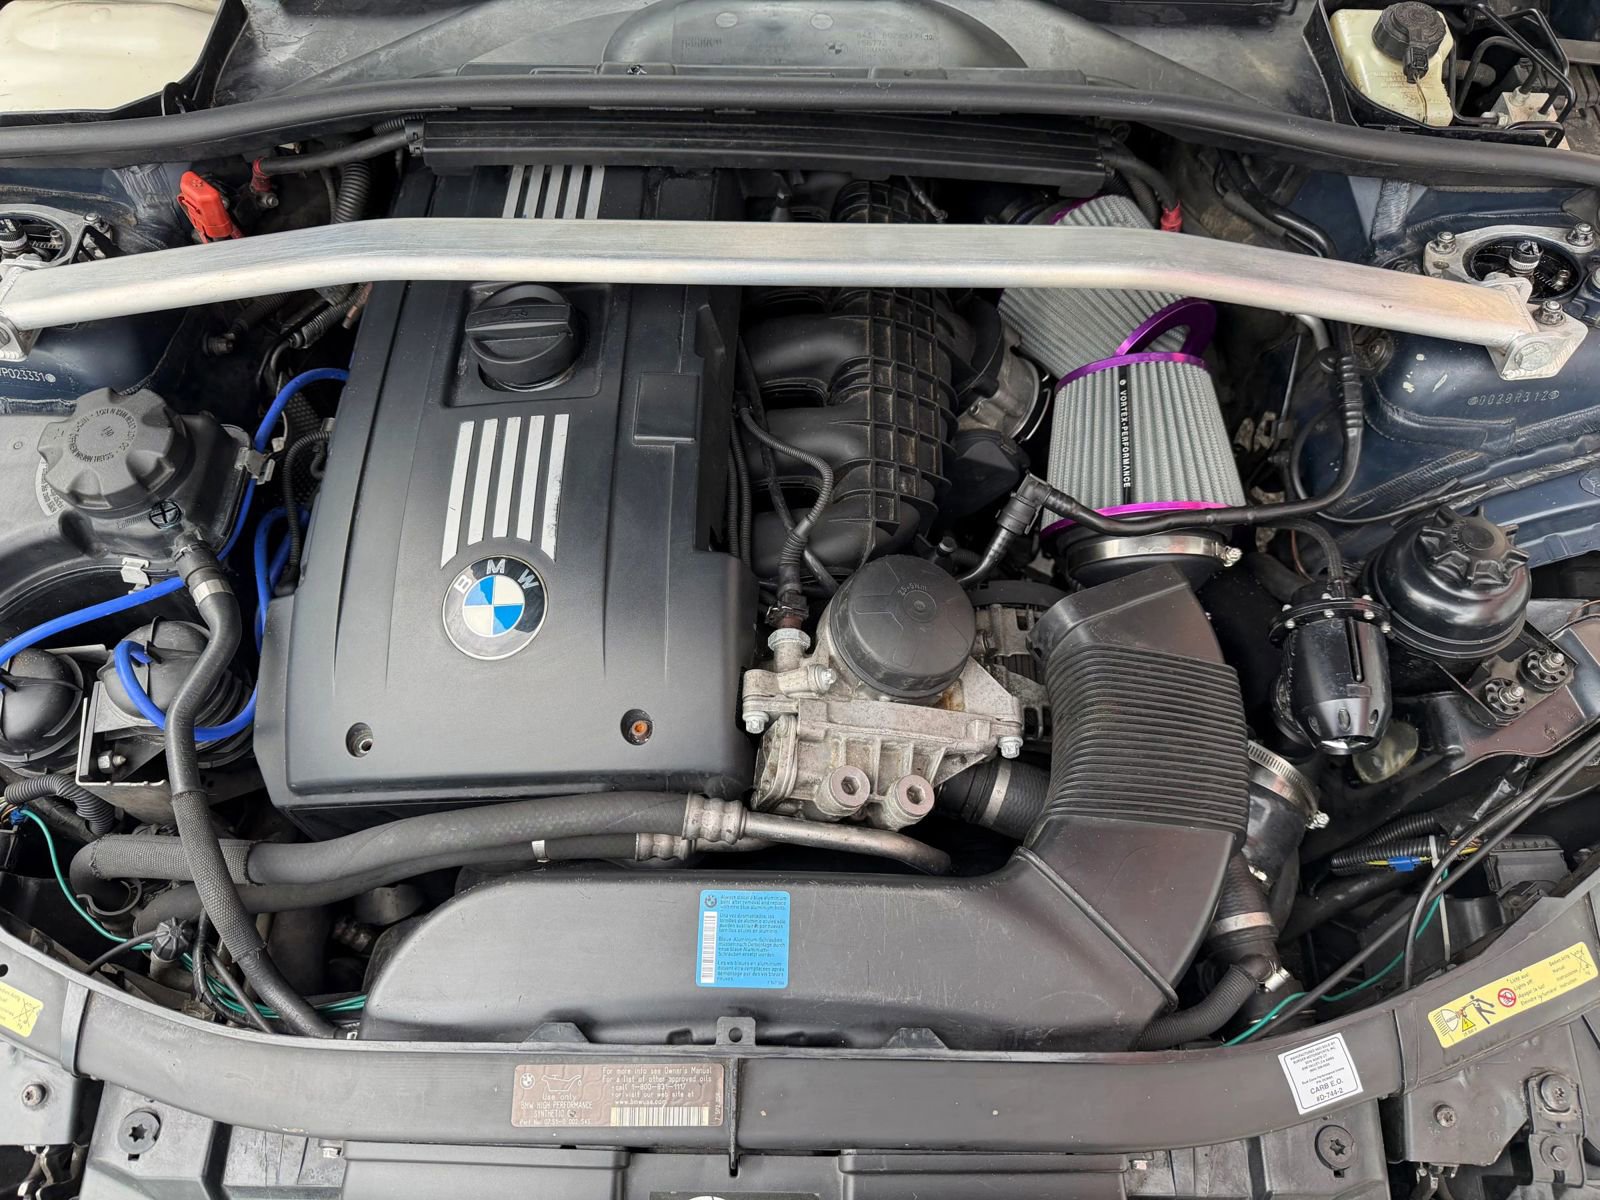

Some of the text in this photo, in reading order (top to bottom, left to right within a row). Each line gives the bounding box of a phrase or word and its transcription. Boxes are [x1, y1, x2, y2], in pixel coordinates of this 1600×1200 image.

[454, 558, 540, 594] BMW
[602, 1076, 612, 1084] For
[622, 1076, 632, 1084] list
[649, 1076, 666, 1084] other
[668, 1076, 697, 1084] approved
[700, 1076, 712, 1084] oils
[1310, 1084, 1329, 1094] CARB
[1331, 1078, 1343, 1087] E.O.
[542, 1093, 576, 1101] Use only
[1316, 1088, 1343, 1102] #D-744-2
